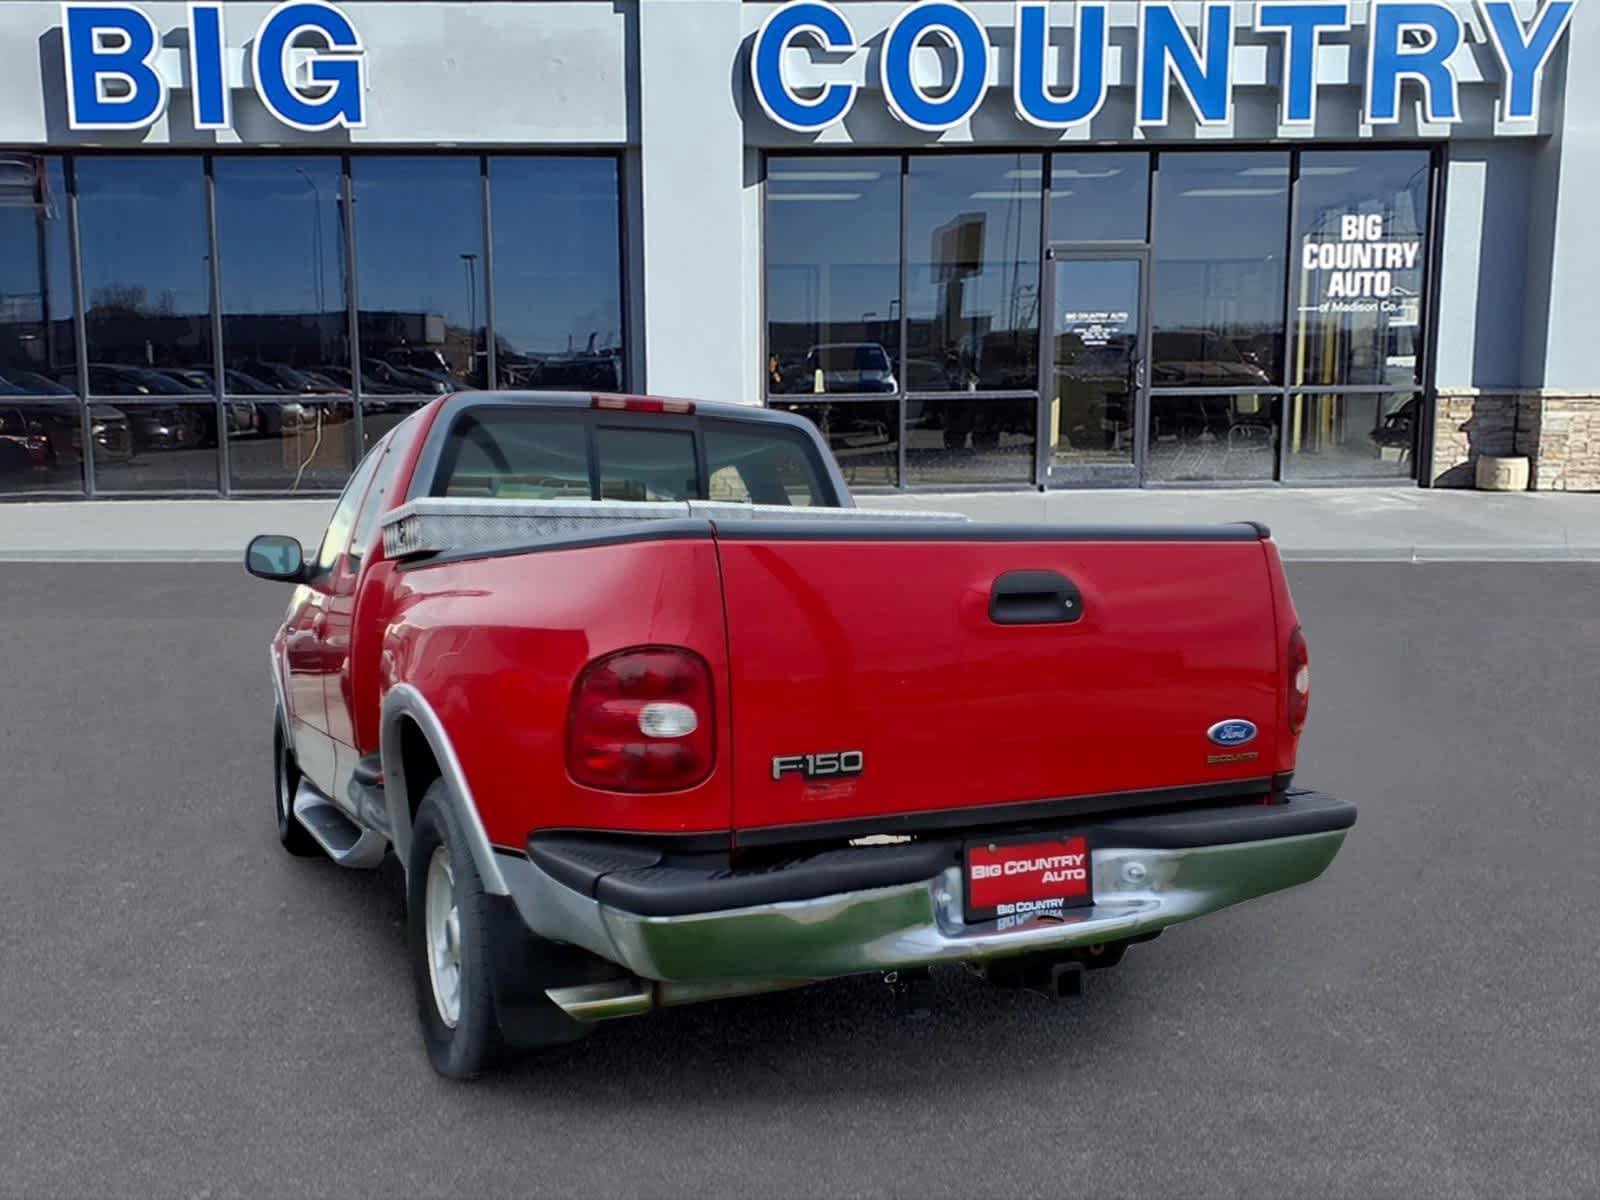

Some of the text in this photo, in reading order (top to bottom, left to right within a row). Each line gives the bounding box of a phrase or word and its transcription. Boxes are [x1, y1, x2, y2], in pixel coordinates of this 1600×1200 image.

[63, 0, 1574, 133] BIG COUNTRY
[1342, 214, 1382, 240] BIG
[1303, 242, 1419, 269] COUNTRY
[1328, 271, 1391, 297] AUTO
[1332, 302, 1378, 312] Madison
[971, 854, 1085, 879] BIG COUNTRY
[1042, 868, 1086, 883] AUTO
[997, 898, 1064, 915] BIG COUNTRY
